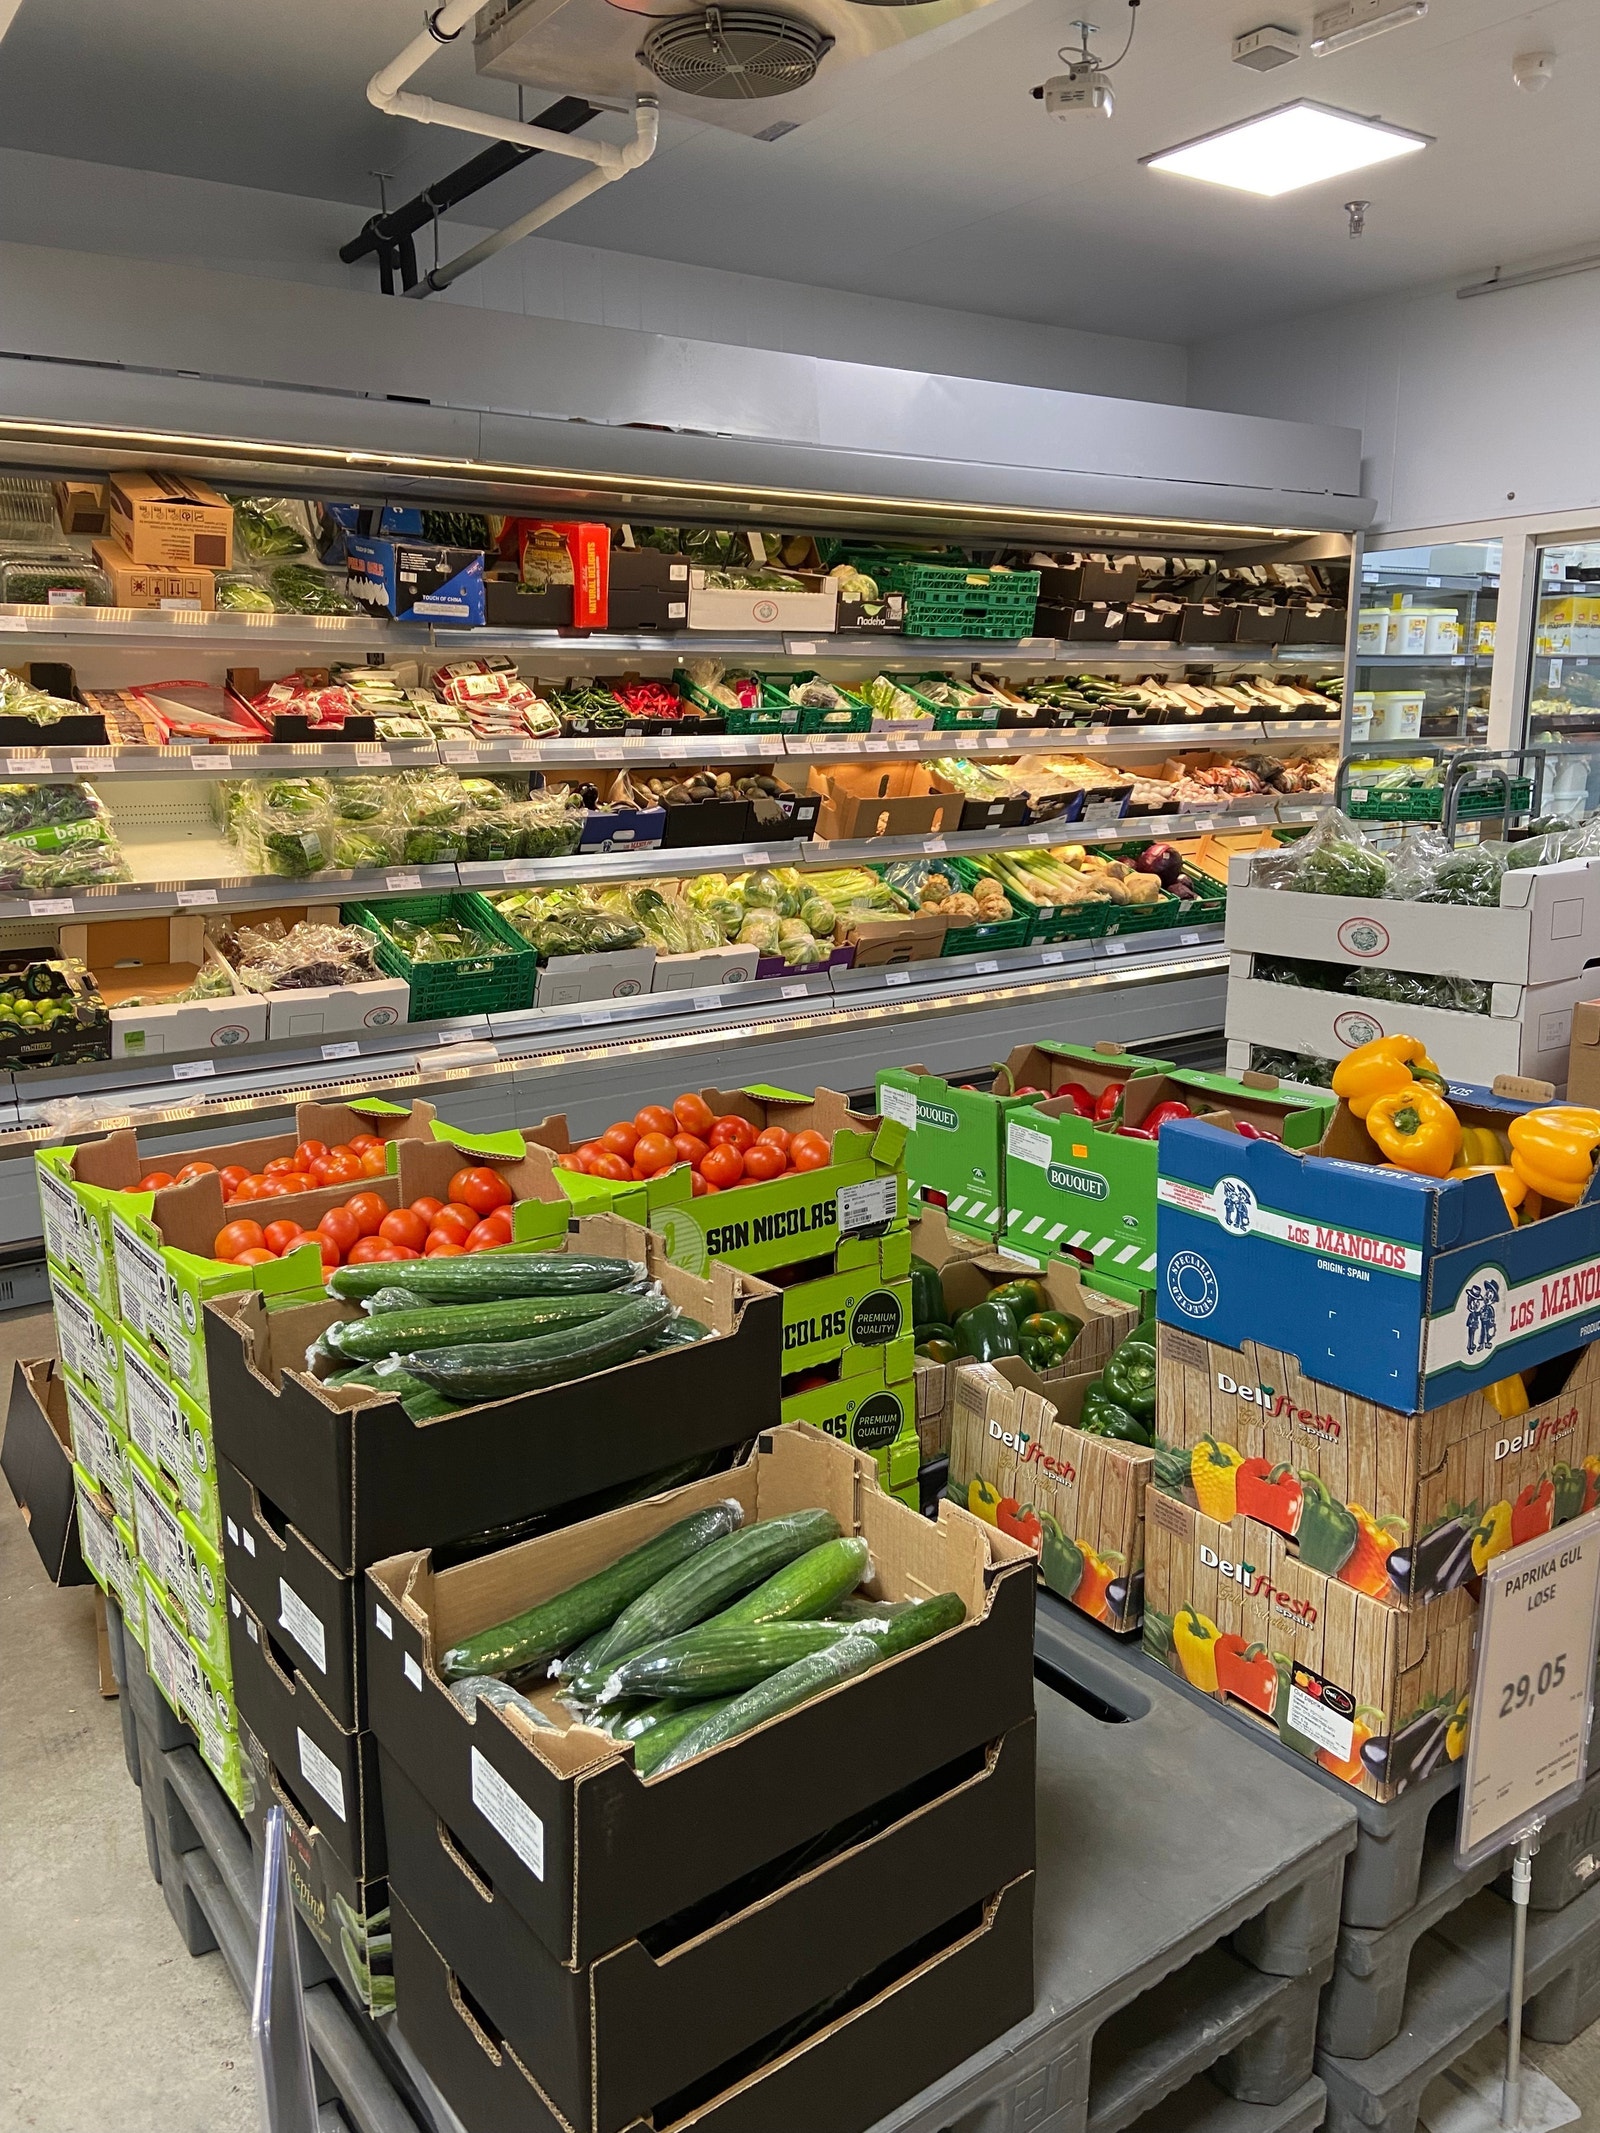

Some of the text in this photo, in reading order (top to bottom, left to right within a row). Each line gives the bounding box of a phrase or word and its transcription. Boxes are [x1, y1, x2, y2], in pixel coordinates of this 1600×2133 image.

[587, 541, 596, 579] DELIGHTS
[422, 594, 439, 602] TOUCH
[916, 1104, 956, 1126] BOUQUET
[1051, 1169, 1103, 1195] BOUQUET
[706, 1221, 749, 1256] SAN
[753, 1199, 837, 1245] NICOLAS
[1287, 1224, 1407, 1270] LOS MANOLOS
[1171, 1254, 1215, 1286] SPECIALLY
[1317, 1259, 1370, 1282] ORIGIN: SPAIN
[1171, 1285, 1214, 1314] SELECTED
[857, 1312, 896, 1323] PREMIUM
[1509, 1299, 1535, 1332] LOS
[783, 1309, 847, 1350] COLAS
[856, 1324, 895, 1335] QUALITY!
[857, 1425, 896, 1437] QUALITY!
[858, 1413, 897, 1425] PREMIUM
[1297, 1423, 1339, 1445] spain
[1043, 1469, 1073, 1489] spain
[1505, 1546, 1583, 1597] PAPRIKA GUL
[1528, 1584, 1557, 1611] LØSE
[1274, 1604, 1315, 1631] spain
[1499, 1653, 1567, 1719] 29,05
